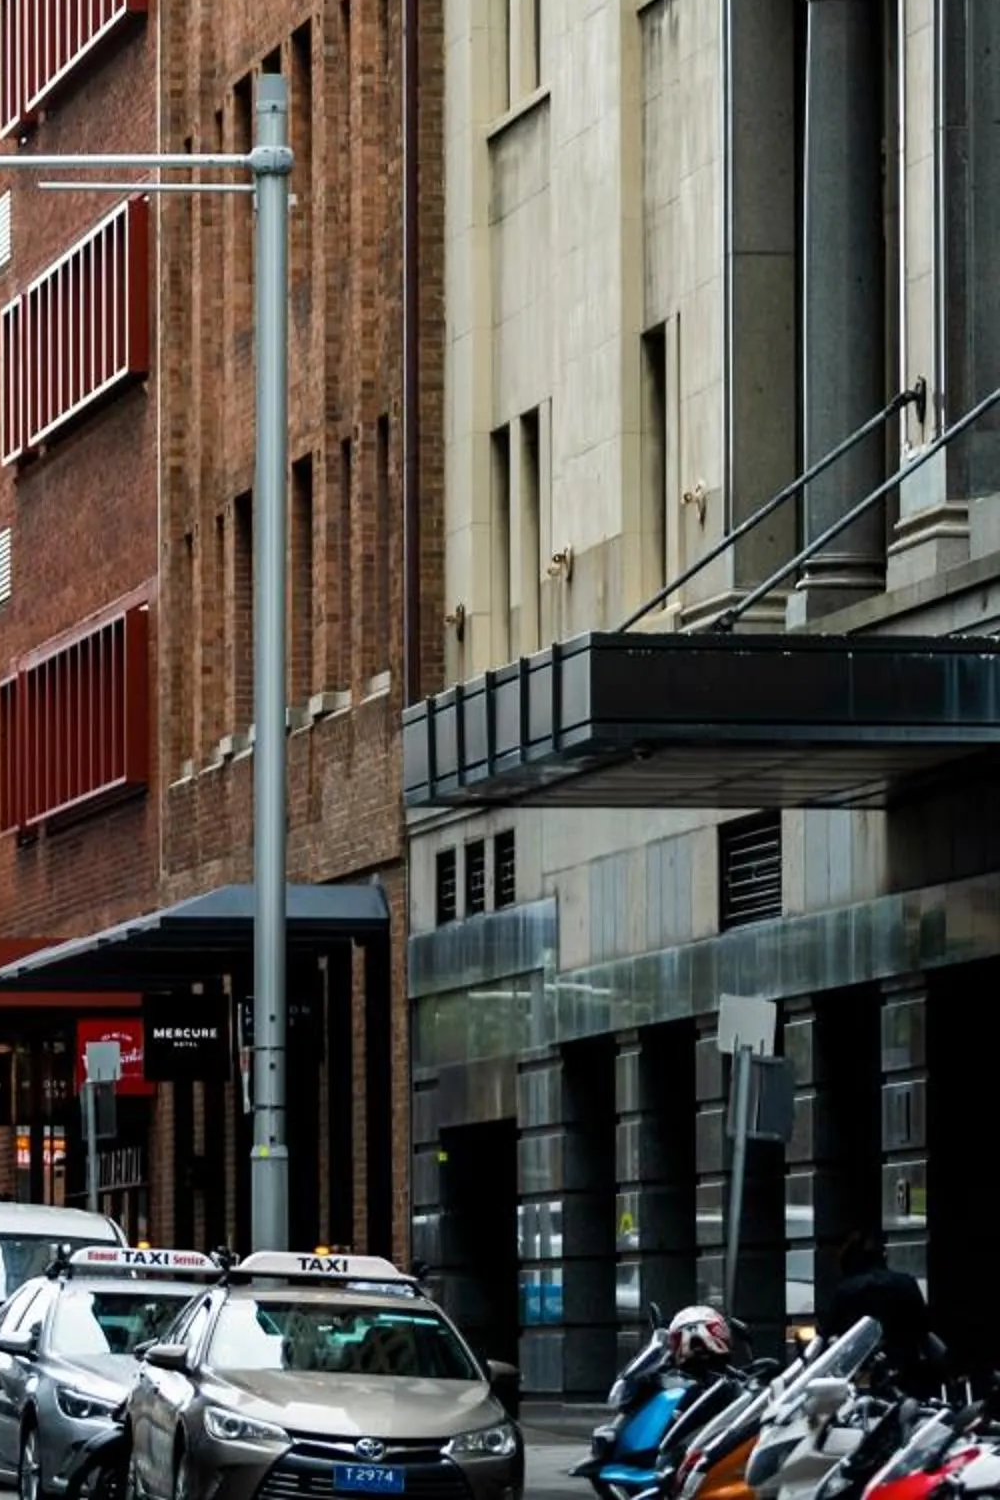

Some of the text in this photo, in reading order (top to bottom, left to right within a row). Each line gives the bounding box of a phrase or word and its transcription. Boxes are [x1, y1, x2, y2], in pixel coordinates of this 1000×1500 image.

[153, 1027, 217, 1039] MERCURE
[122, 1251, 169, 1265] TAXI
[297, 1257, 348, 1273] TAXI
